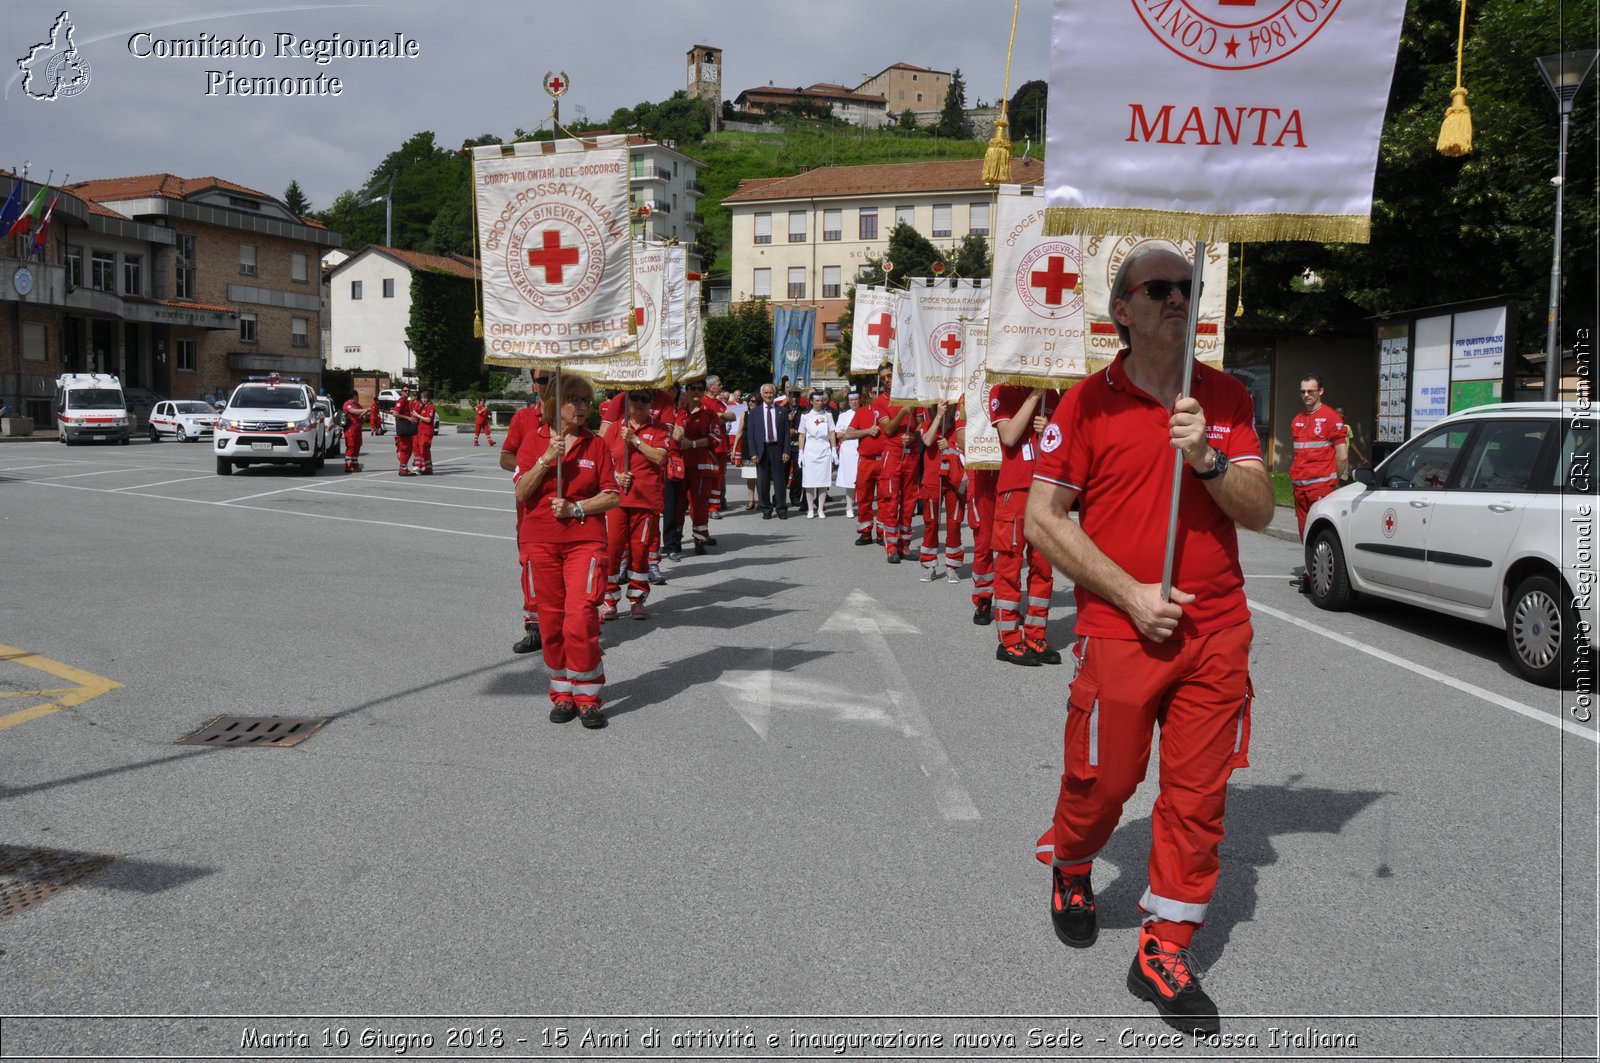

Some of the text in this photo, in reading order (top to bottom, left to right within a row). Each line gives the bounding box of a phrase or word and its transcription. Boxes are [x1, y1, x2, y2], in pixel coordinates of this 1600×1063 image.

[1248, 14, 1298, 57] 1864
[1125, 103, 1308, 148] MANTA
[484, 162, 620, 186] CORPO VOLONTARI DEL SOCCORSO
[515, 182, 568, 206] ROSSA
[571, 185, 625, 245] ITALIANA
[520, 217, 532, 231] DI
[533, 205, 583, 226] GINEVRA
[583, 224, 596, 240] 22
[1006, 213, 1037, 248] CROCE
[509, 233, 546, 306] CONVENZIONE
[585, 241, 602, 285] AGOSTO
[1018, 254, 1035, 308] CONVENZIONE
[1034, 248, 1042, 258] DI
[1043, 244, 1075, 256] GINEVRA
[489, 316, 628, 337] GRUPPO DI MELLE
[1003, 325, 1056, 337] COMITATO
[491, 335, 628, 355] COMITATO LOCALE
[1044, 342, 1056, 352] DI
[1455, 334, 1503, 347] PER QUESTO SPAZIO
[1020, 355, 1076, 369] BUSCA
[1212, 425, 1231, 433] ROSSA
[968, 446, 1000, 454] BORGO
